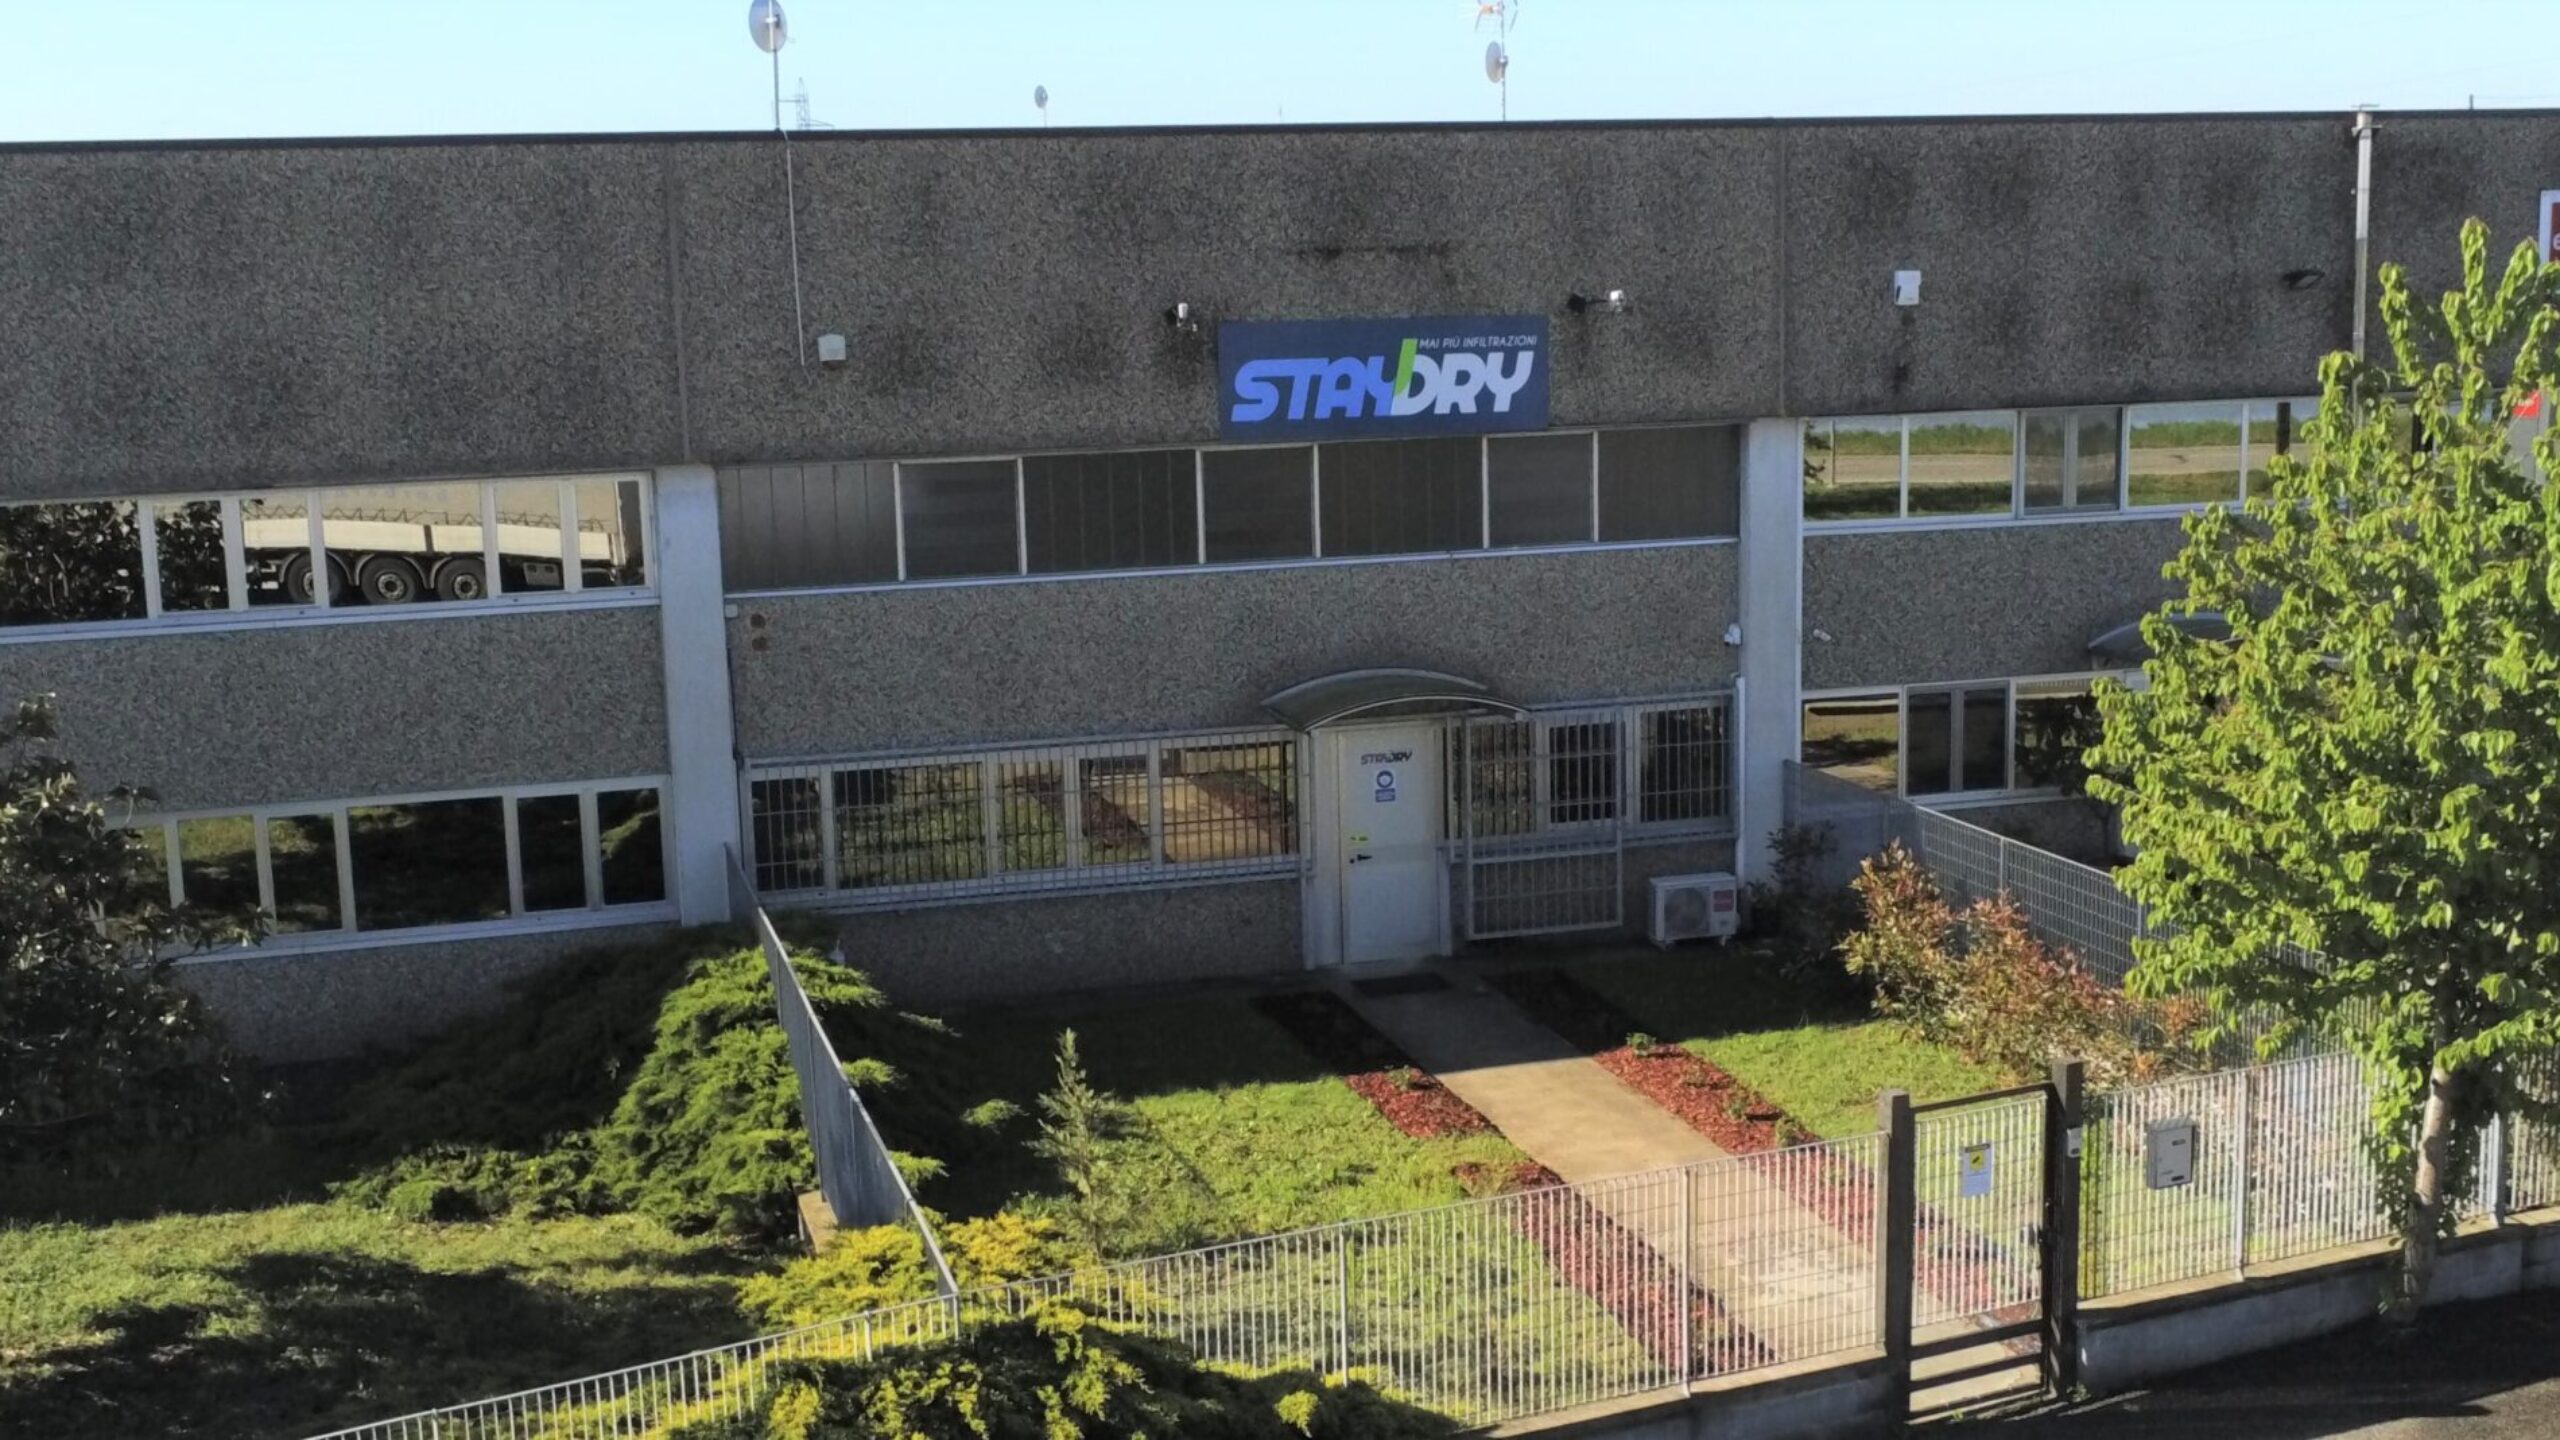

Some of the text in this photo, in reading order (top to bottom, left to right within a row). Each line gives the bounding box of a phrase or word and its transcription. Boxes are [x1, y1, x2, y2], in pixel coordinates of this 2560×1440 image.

[1419, 335, 1538, 349] MAI PIÙ INFILTRAZIONI
[1231, 338, 1534, 422] STAYDRY
